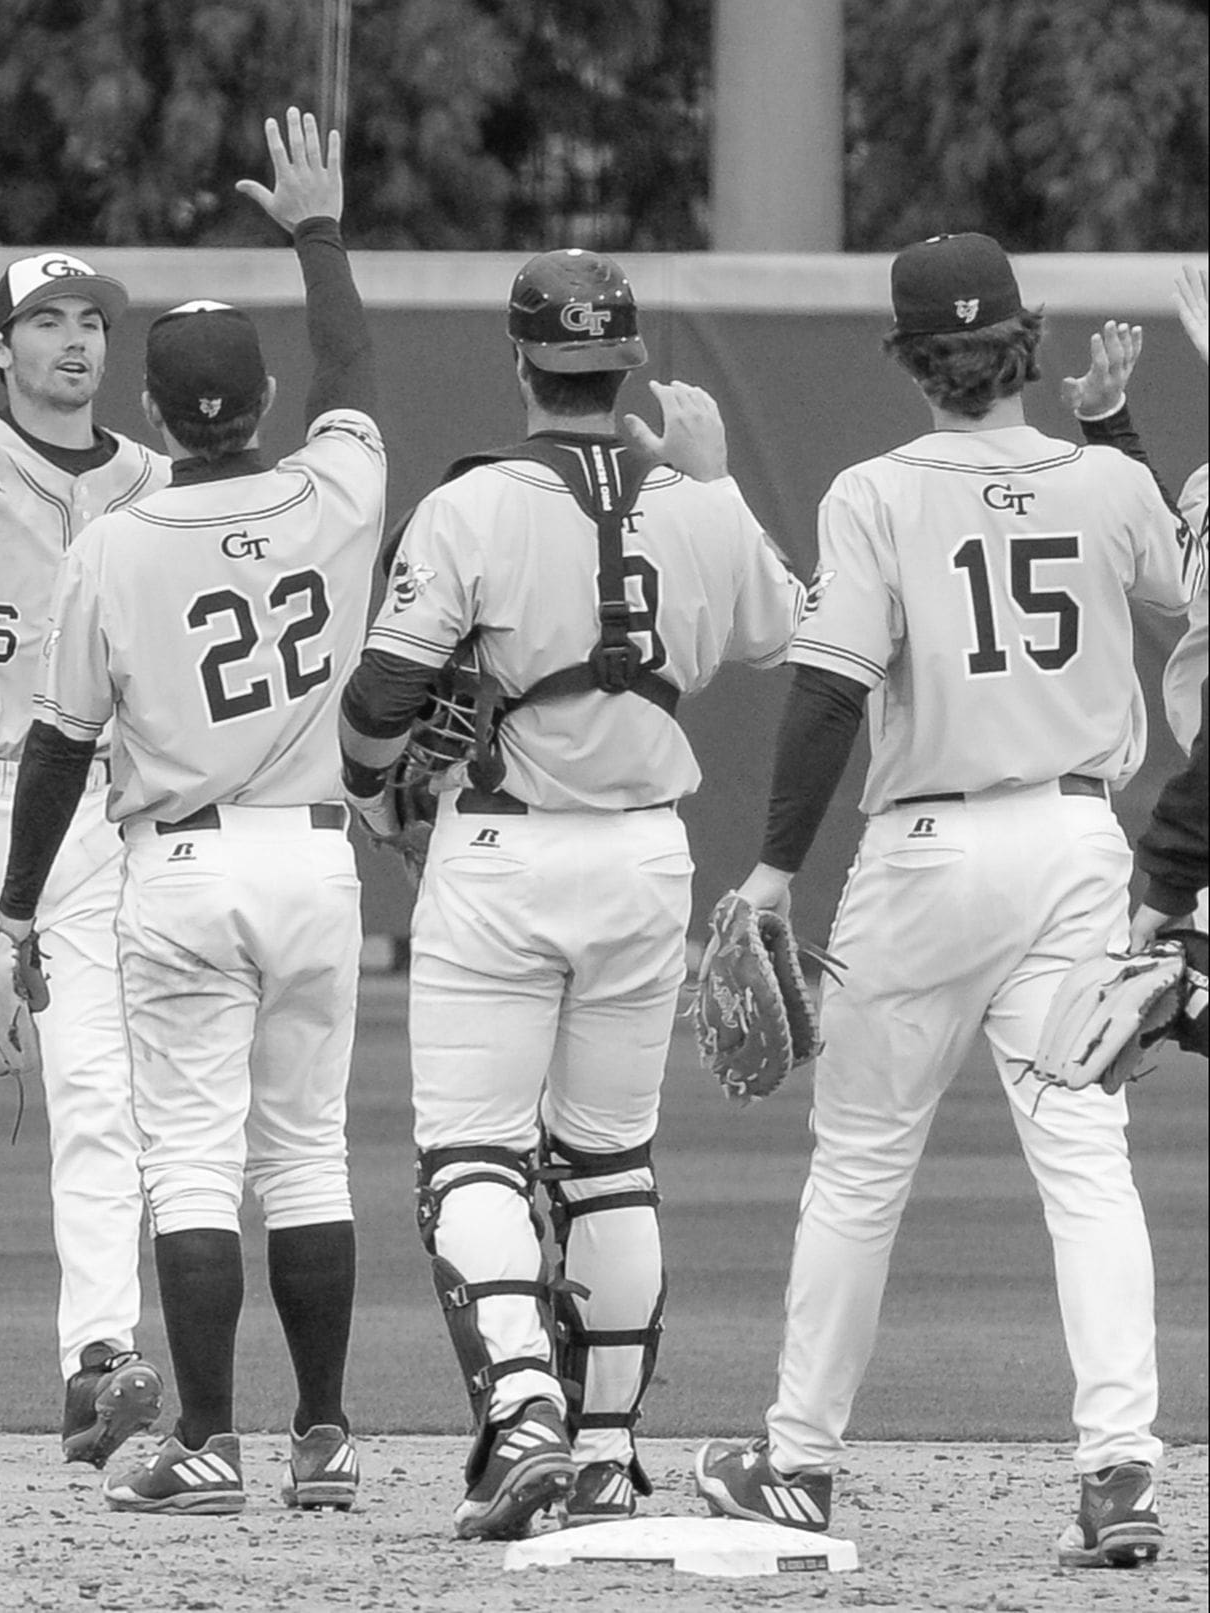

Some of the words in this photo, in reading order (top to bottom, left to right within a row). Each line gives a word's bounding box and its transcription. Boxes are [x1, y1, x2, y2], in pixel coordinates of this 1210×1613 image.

[560, 302, 611, 336] GT
[983, 484, 1035, 516] GT
[221, 530, 270, 561] GT
[953, 536, 1080, 674] 15
[187, 568, 331, 723] 22
